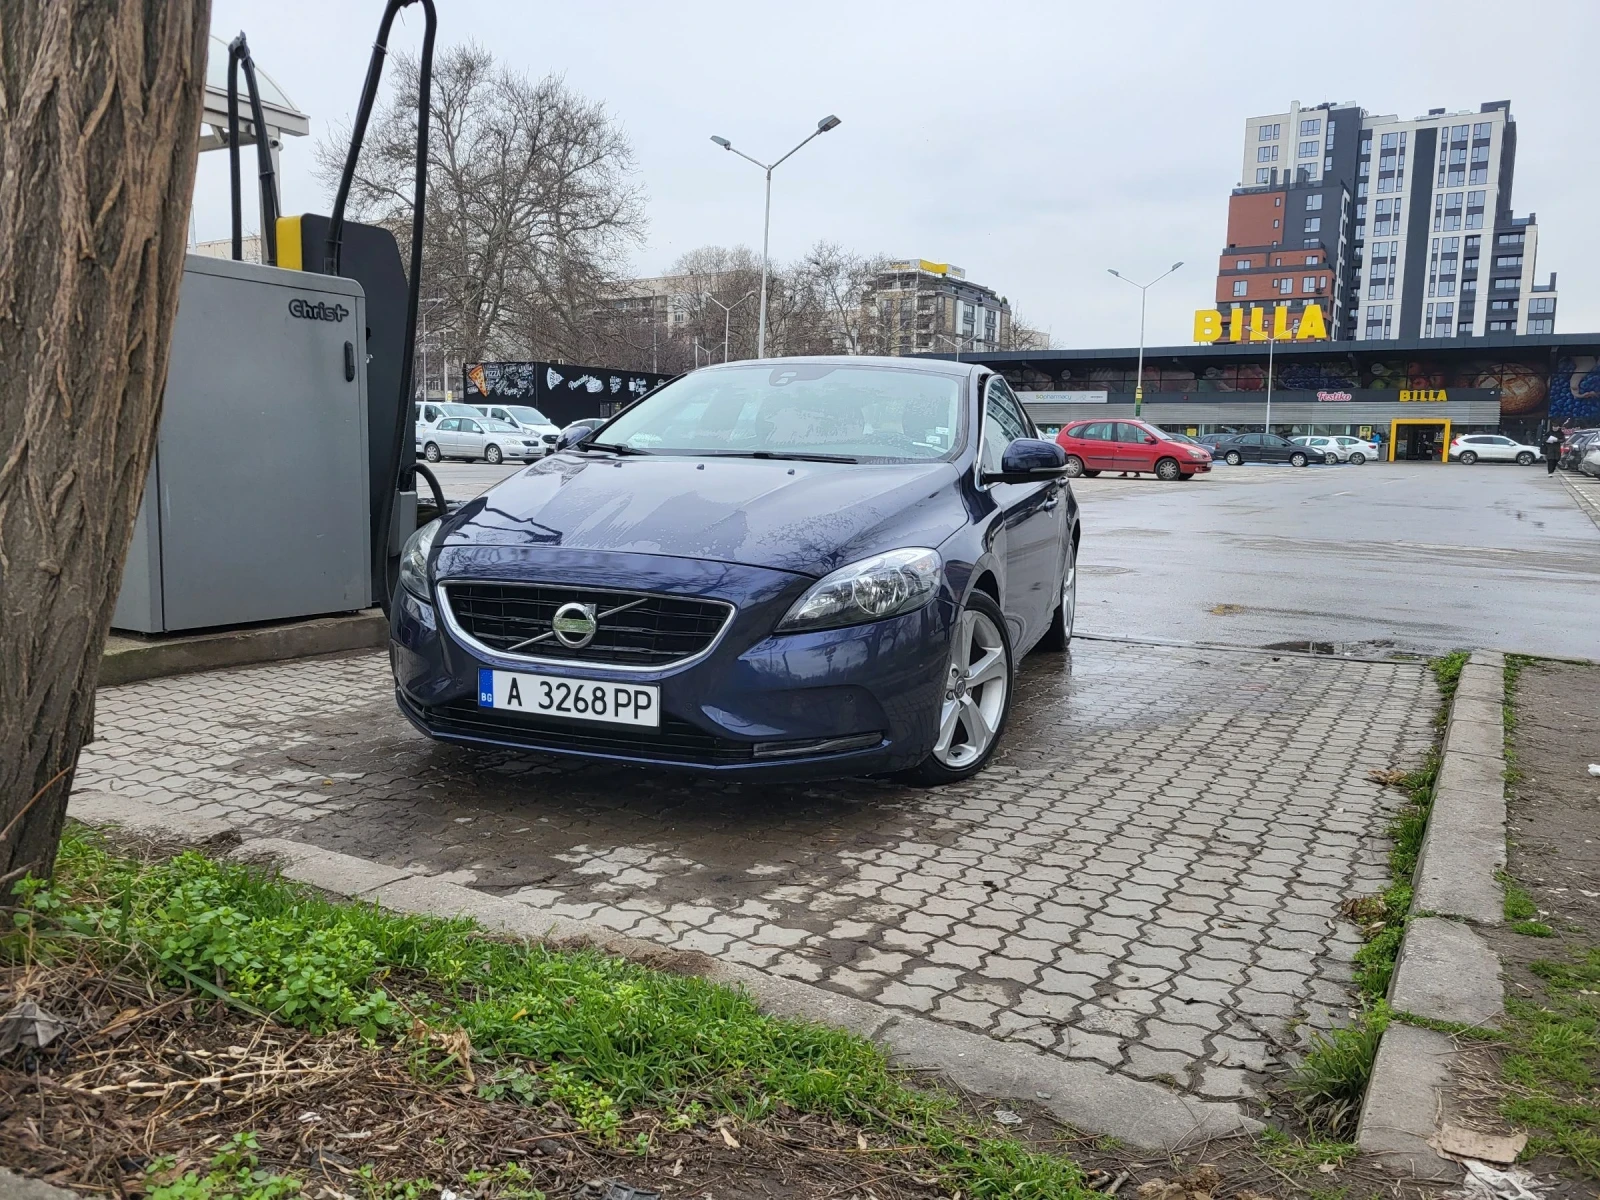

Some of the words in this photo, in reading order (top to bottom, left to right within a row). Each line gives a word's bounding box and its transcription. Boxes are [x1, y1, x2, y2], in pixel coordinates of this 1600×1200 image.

[288, 298, 349, 322] Christ
[1193, 304, 1327, 342] BILLA
[1316, 391, 1352, 402] Festiko
[1399, 389, 1448, 402] BILLA
[481, 692, 493, 702] BG
